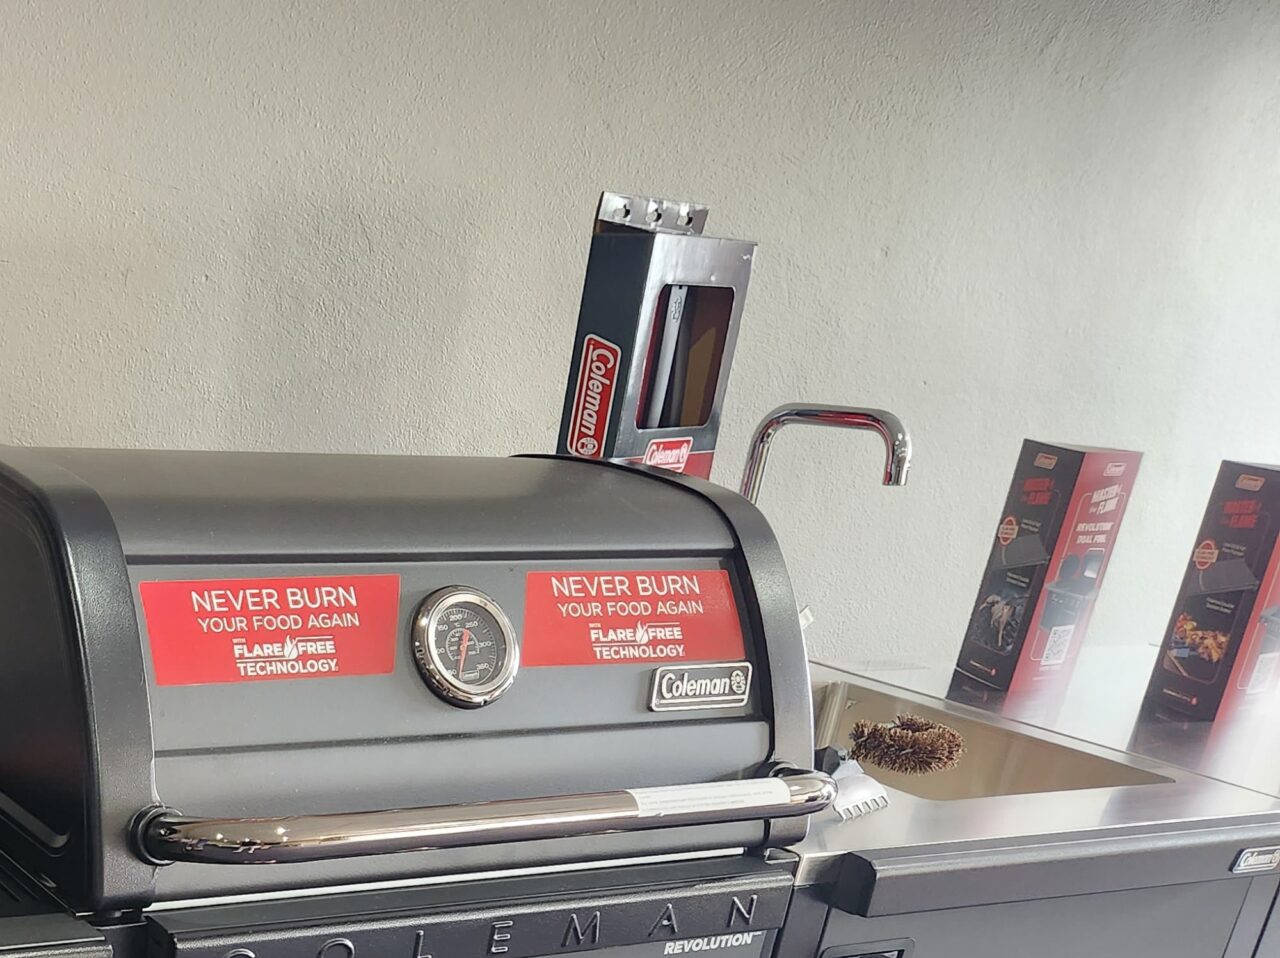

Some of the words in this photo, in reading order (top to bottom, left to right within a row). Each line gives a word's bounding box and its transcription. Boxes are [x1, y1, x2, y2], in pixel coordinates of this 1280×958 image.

[580, 348, 615, 436] Coleman
[646, 443, 680, 466] Coleman
[551, 576, 632, 597] NEVER
[636, 575, 700, 595] BURN
[191, 589, 280, 612] NEVER
[287, 586, 358, 609] BURN
[557, 602, 603, 618] YOUR
[607, 601, 652, 617] FOOD
[656, 600, 704, 615] AGAIN
[197, 617, 248, 633] YOUR
[253, 614, 302, 631] FOOD
[307, 612, 360, 629] AGAIN
[465, 621, 478, 629] 250
[590, 627, 635, 642] FLARE
[648, 626, 683, 640] FREE
[234, 643, 284, 658] FLARE
[297, 641, 336, 655] FREE
[661, 671, 731, 699] Coleman
[1240, 852, 1272, 867] Coleman
[664, 933, 753, 955] REVOLUTION
